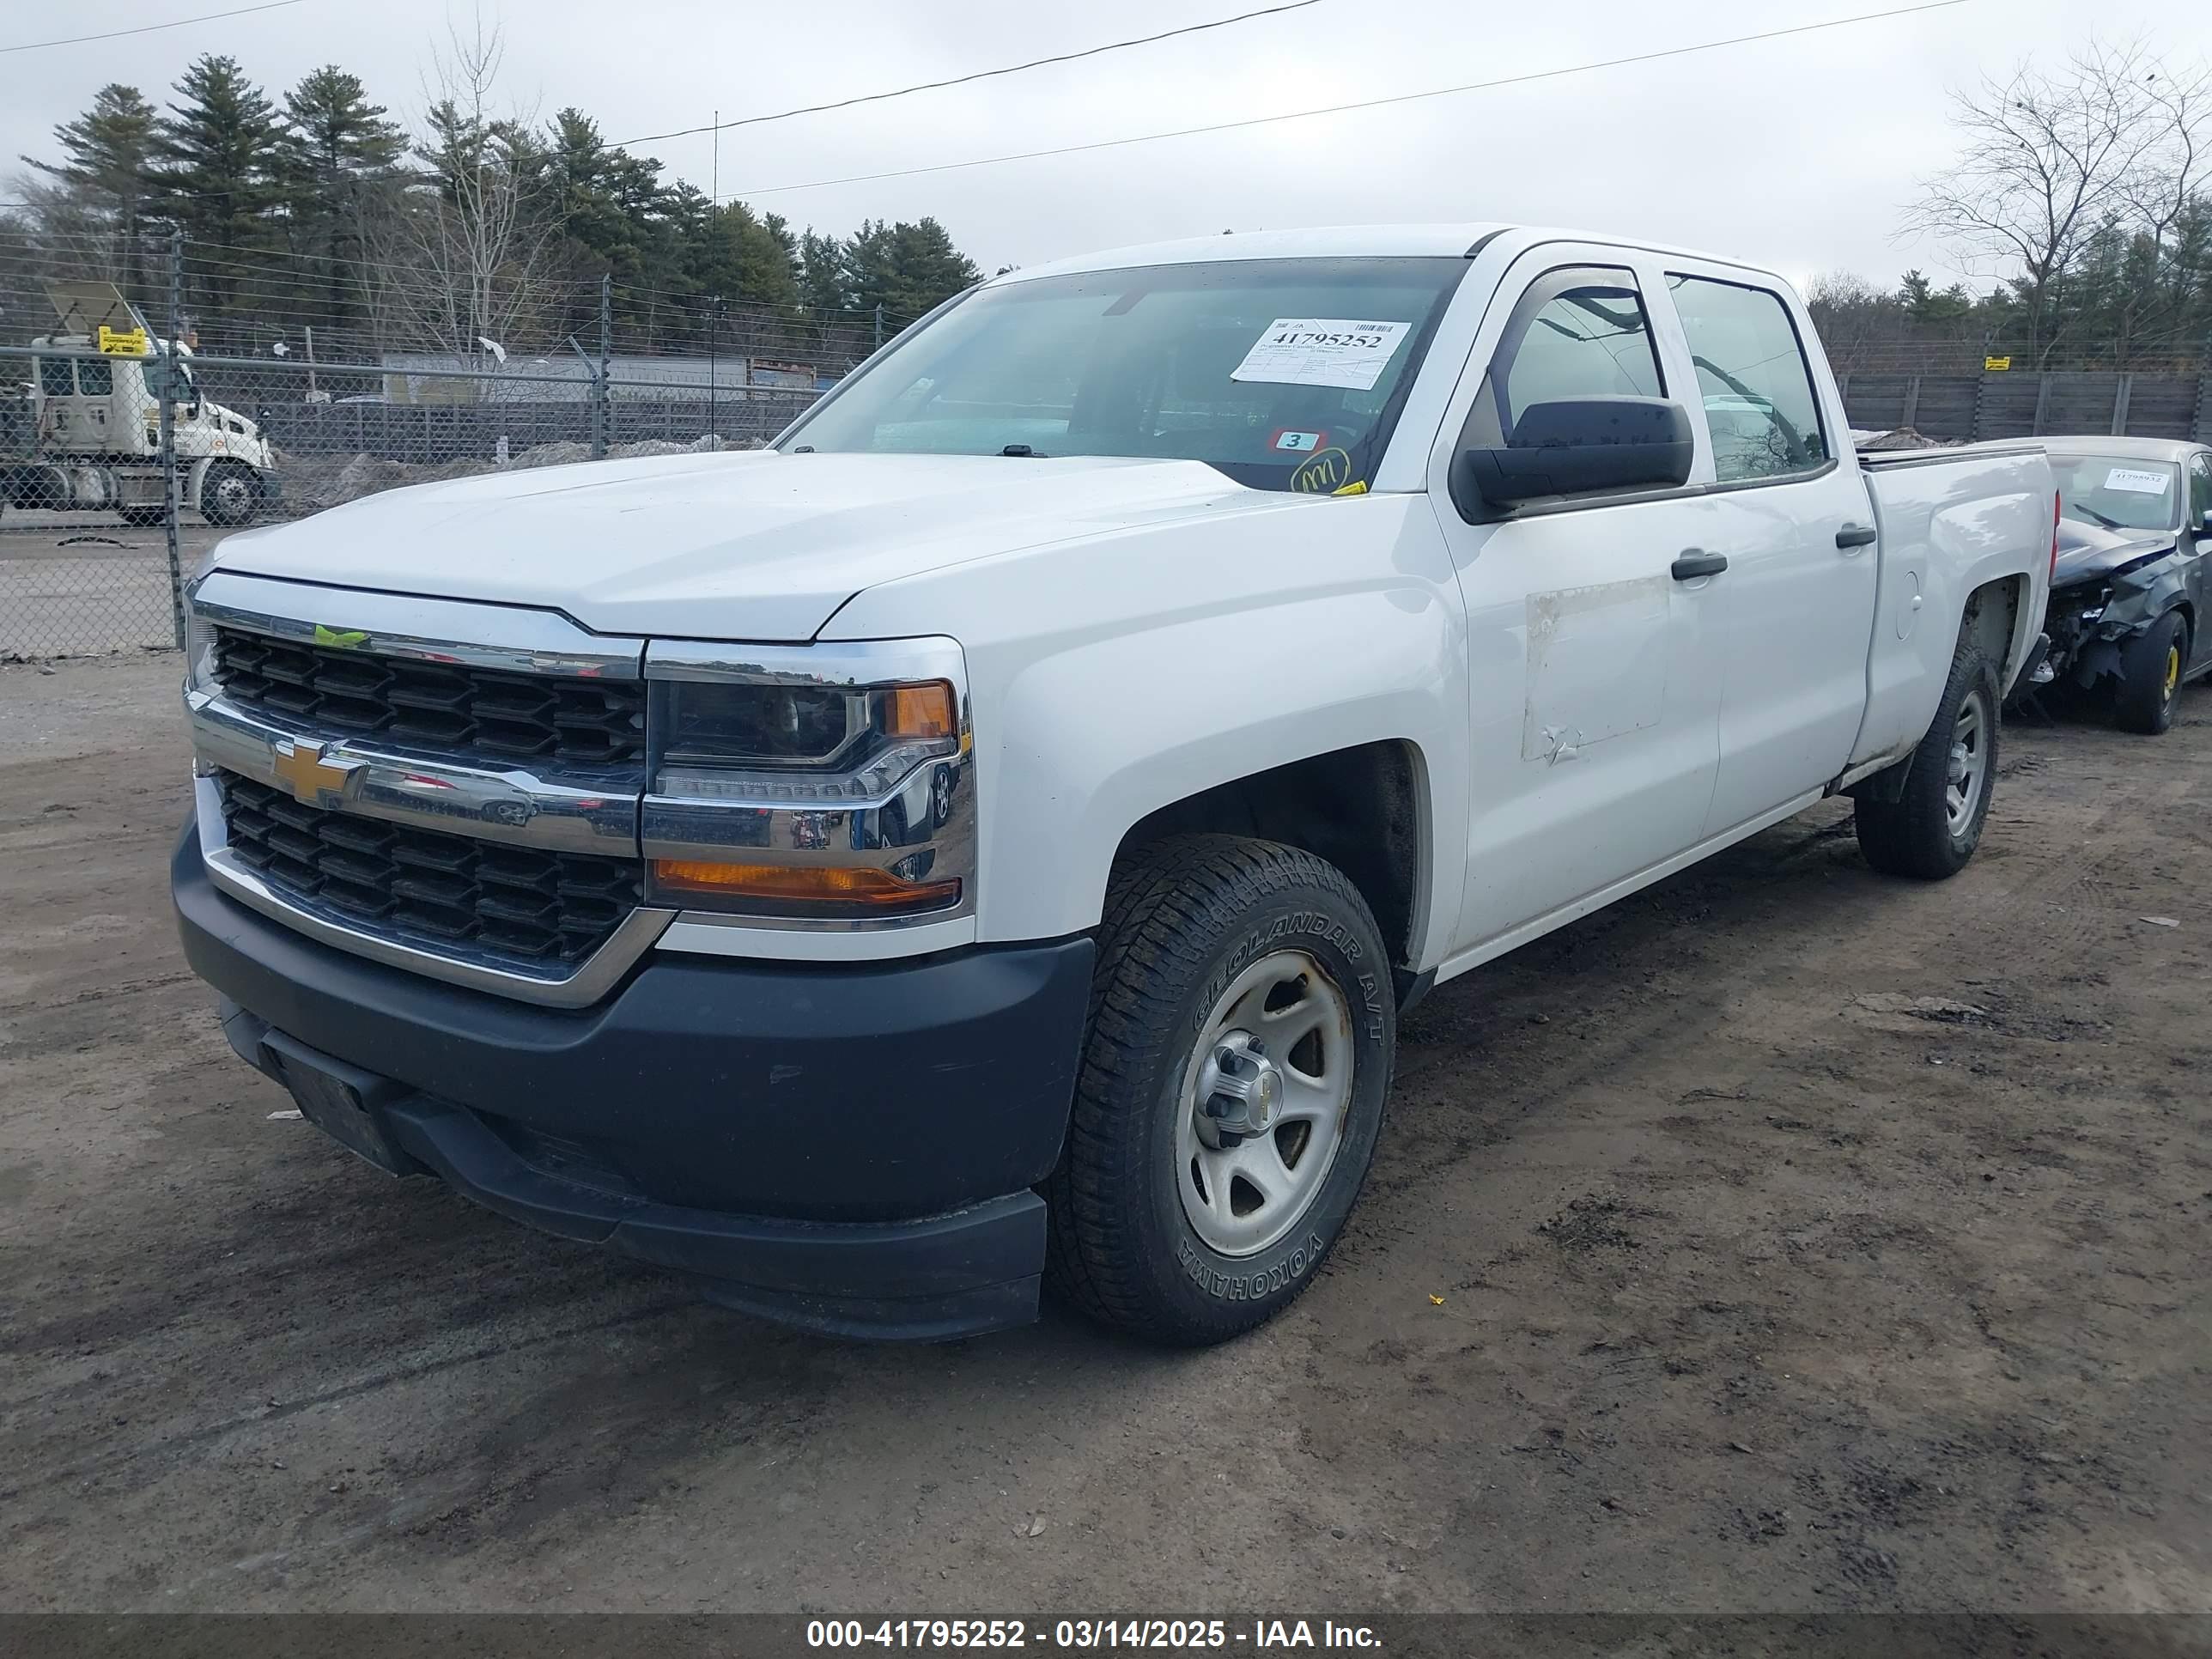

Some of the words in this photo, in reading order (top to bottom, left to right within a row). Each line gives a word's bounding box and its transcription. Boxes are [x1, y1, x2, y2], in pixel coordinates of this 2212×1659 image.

[1273, 332, 1382, 349] 41795252
[1285, 434, 1302, 447] 3
[1193, 911, 1363, 1031] GEOLANDAR
[1357, 973, 1386, 1047] A/T
[1176, 1231, 1324, 1301] YOKOHAMA
